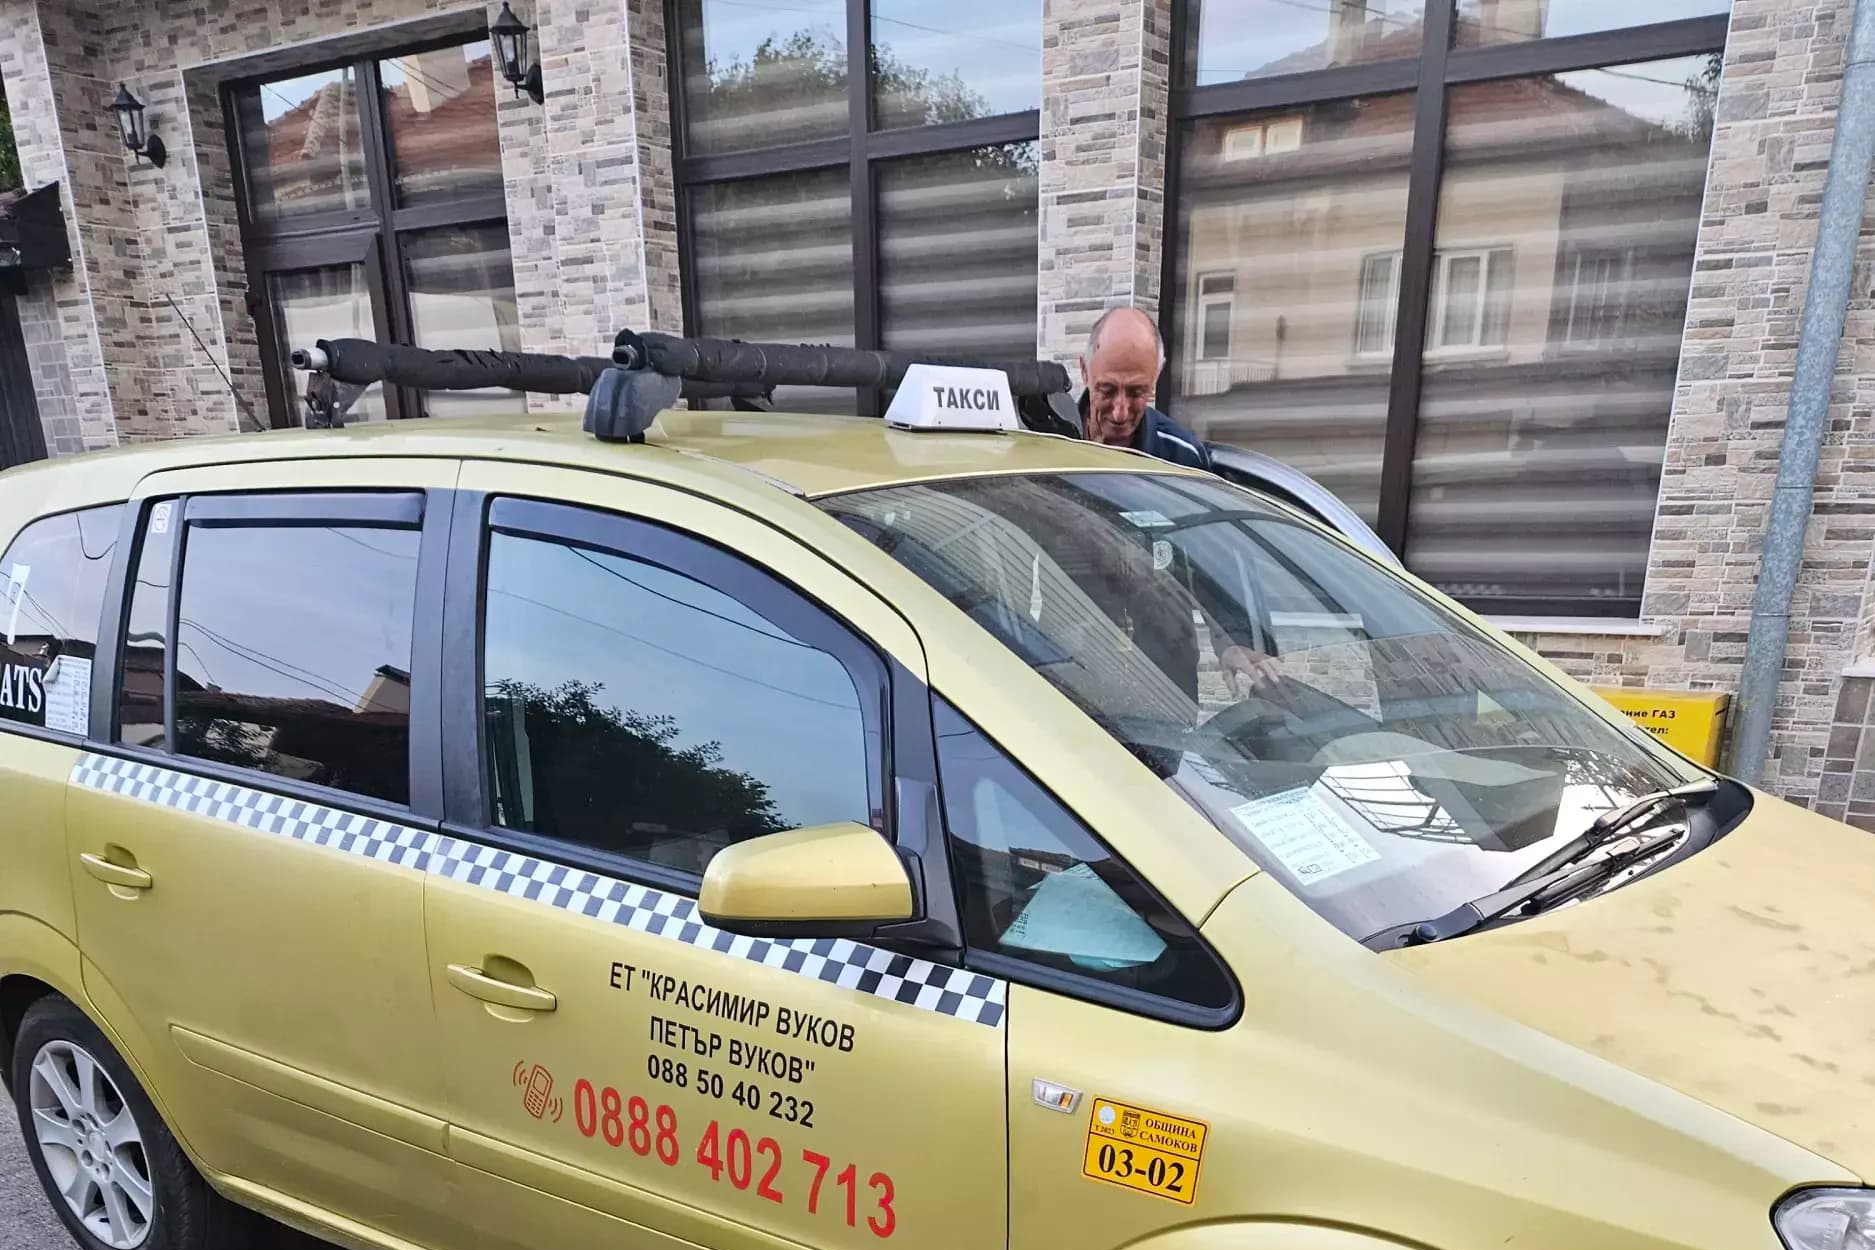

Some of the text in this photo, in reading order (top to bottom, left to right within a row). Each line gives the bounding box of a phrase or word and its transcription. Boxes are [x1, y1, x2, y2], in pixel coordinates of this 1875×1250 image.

[933, 386, 1000, 410] ТАКСИ
[1620, 709, 1676, 719] ние ГАЗ
[610, 961, 857, 1053] ЕТ "КРАСИМИР ВУКОВ
[649, 1016, 816, 1084] ПЕТЪР ВУКОВ"
[647, 1054, 814, 1128] 088 50 40 232
[1139, 1130, 1198, 1153] САМОКОВ
[1145, 1118, 1196, 1139] ОБЩИНА
[574, 1078, 897, 1239] 0888 402 713
[1099, 1144, 1185, 1193] 03-02
